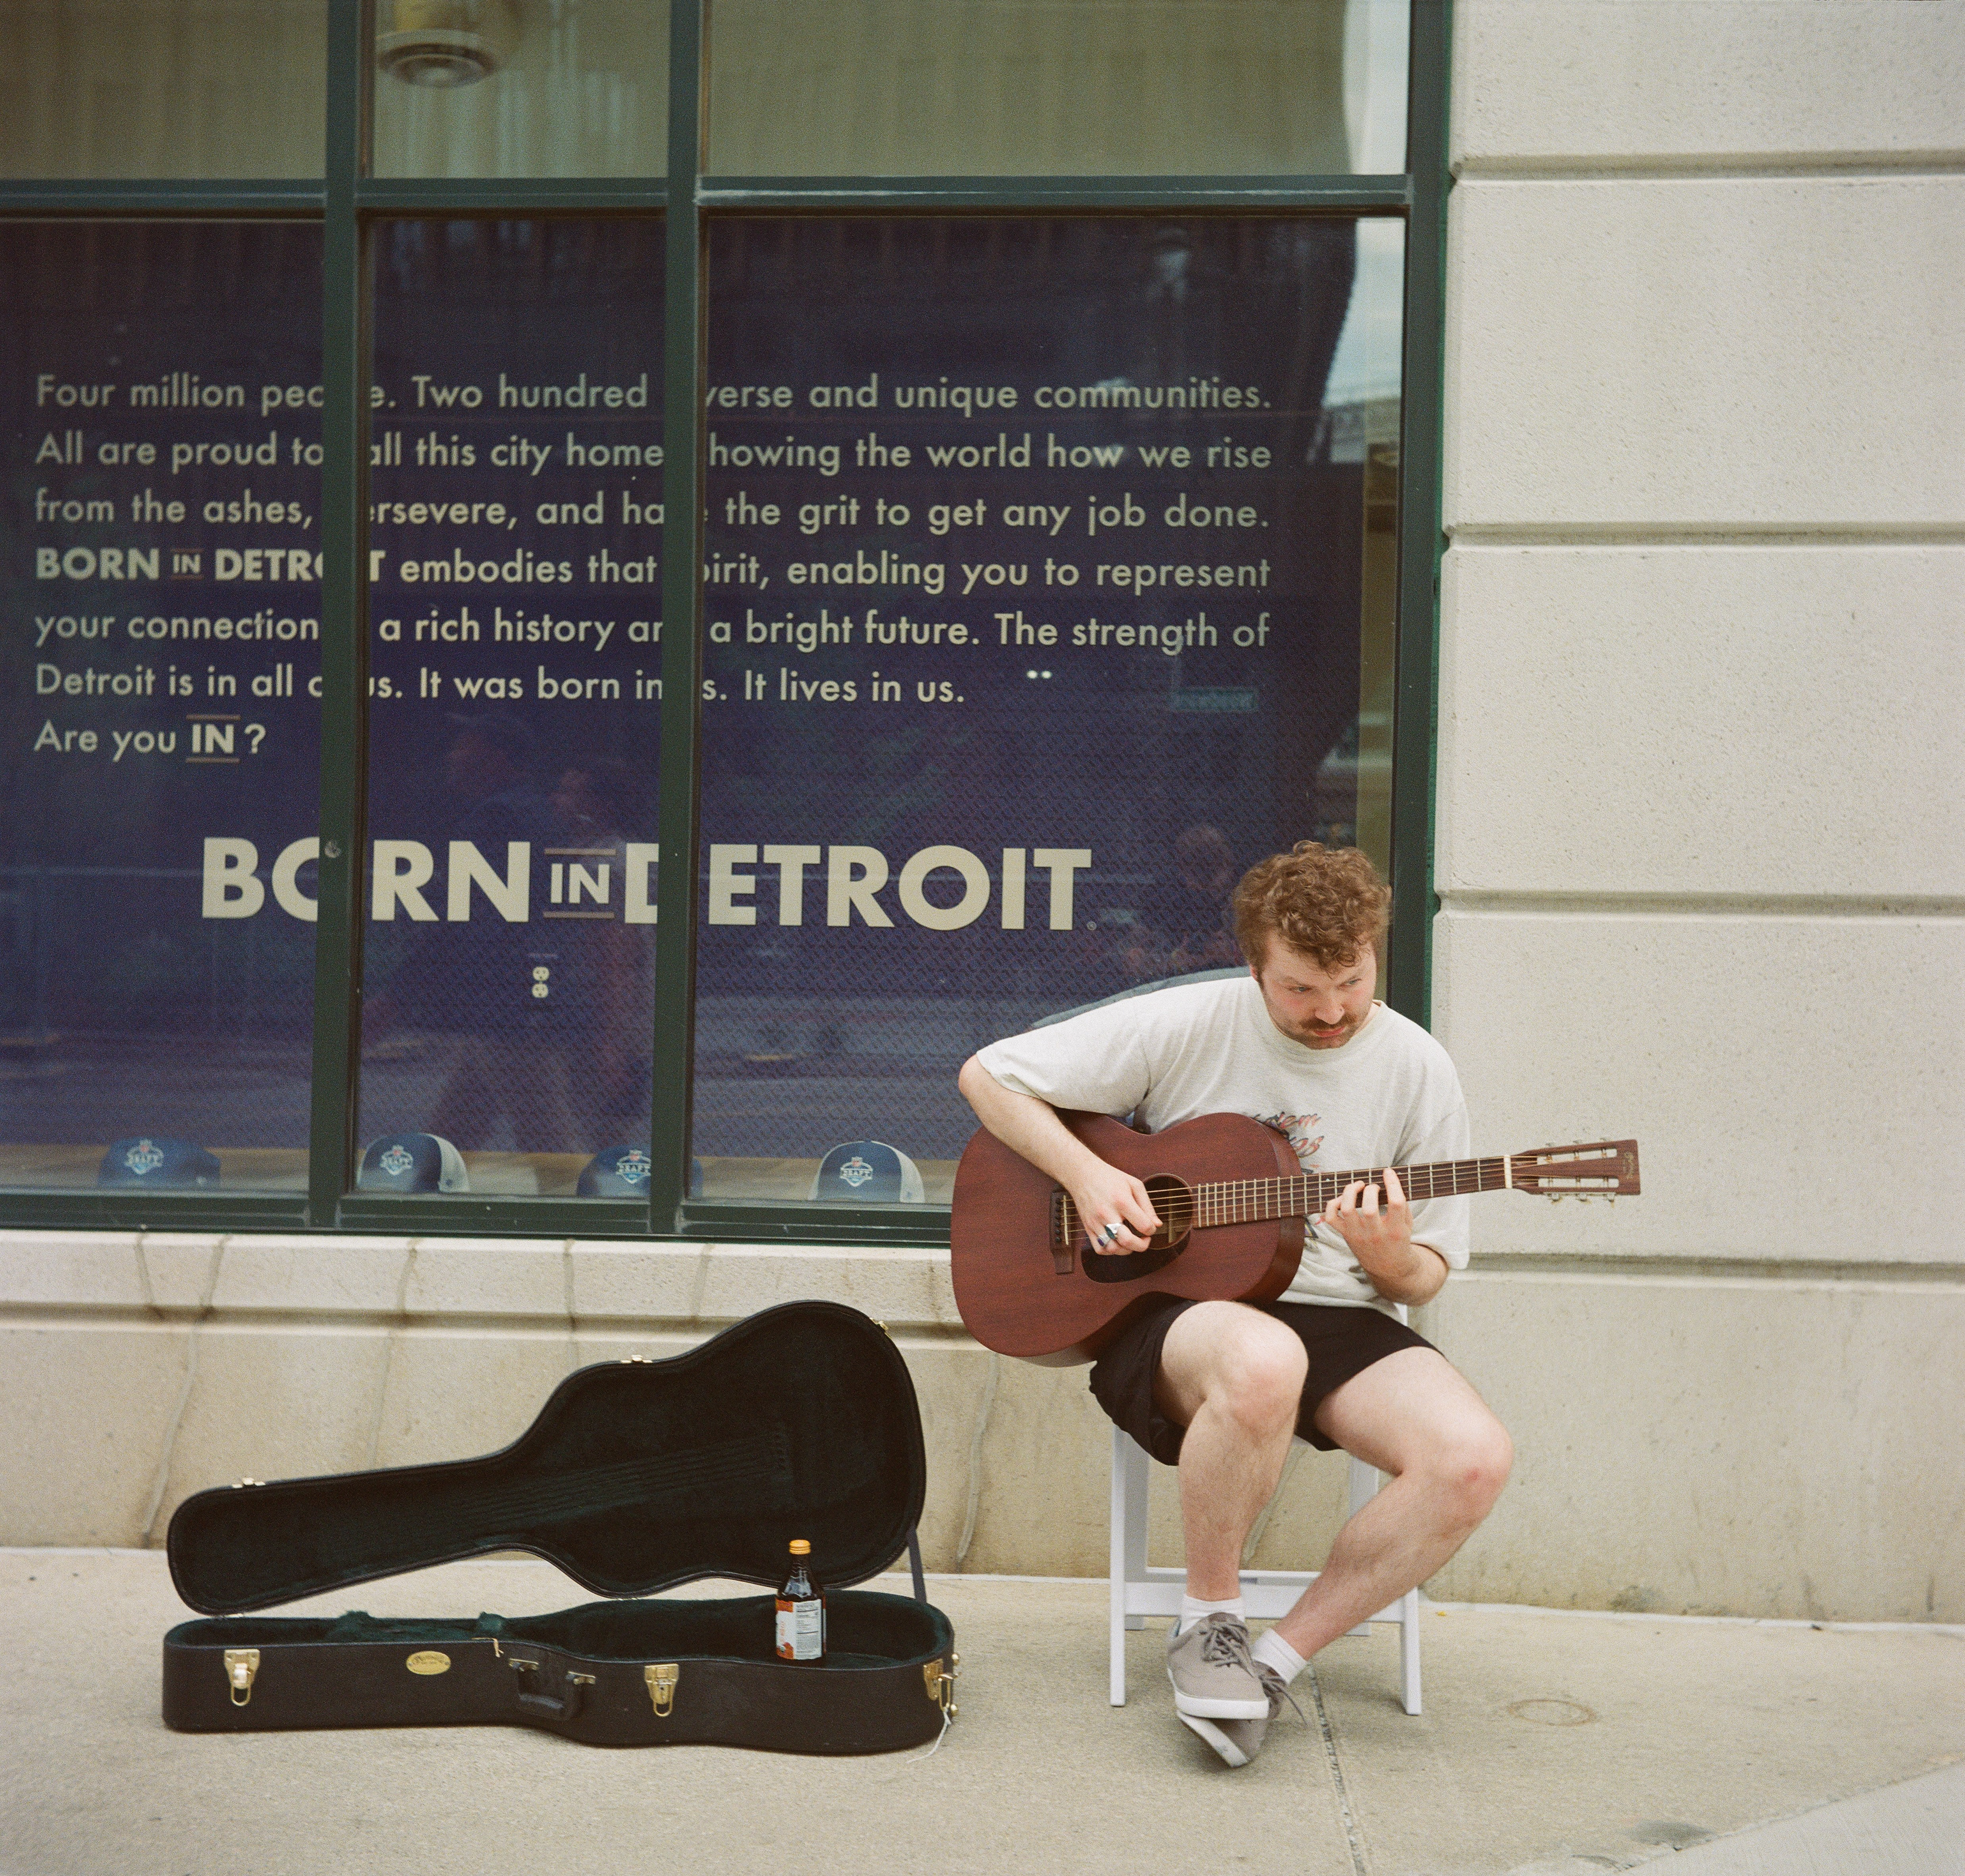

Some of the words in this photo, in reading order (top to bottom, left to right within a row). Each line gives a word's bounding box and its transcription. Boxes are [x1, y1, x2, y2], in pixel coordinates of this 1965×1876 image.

[37, 374, 116, 407] Four
[131, 372, 245, 407] million
[261, 386, 396, 417] peoe.
[411, 375, 483, 408] Two
[499, 373, 647, 408] hundred
[707, 386, 793, 408] verse
[809, 373, 878, 408] and
[896, 377, 1018, 418] unique
[1034, 377, 1270, 409] communities.
[36, 430, 83, 464] All
[99, 443, 157, 465] are
[172, 431, 277, 474] proud
[292, 438, 323, 466] to
[371, 432, 401, 466] all
[416, 432, 476, 467] this
[490, 435, 552, 476] city
[566, 432, 664, 467] home
[710, 432, 840, 477] howing
[856, 432, 911, 467] the
[926, 433, 1031, 468] world
[1047, 433, 1124, 468] how
[1138, 446, 1191, 468] we
[1207, 436, 1271, 468] rise
[36, 488, 115, 522] from
[132, 488, 186, 523] the
[203, 489, 312, 529] ashes,
[370, 502, 517, 530] rsevere,
[536, 491, 603, 524] and
[726, 491, 780, 525] the
[799, 495, 860, 535] grit
[876, 498, 910, 526] to
[928, 499, 987, 535] get
[1003, 505, 1071, 536] any
[1088, 492, 1146, 536] job
[1164, 493, 1268, 527] done.
[37, 547, 159, 580] BORN
[173, 554, 201, 573] IN
[215, 549, 386, 582] DETRT
[400, 548, 573, 583] embodies
[587, 548, 657, 583] that
[703, 553, 769, 590] irit,
[788, 550, 945, 595] enabling
[962, 564, 1028, 595] you
[1044, 558, 1079, 586] to
[1097, 560, 1270, 596] represent
[35, 616, 116, 647] your
[128, 608, 319, 640] connection
[379, 620, 401, 641] a
[416, 607, 479, 642] rich
[494, 607, 615, 651] history
[710, 622, 731, 643] a
[747, 609, 854, 653] bright
[865, 609, 979, 645] future.
[994, 610, 1058, 645] The
[1072, 612, 1217, 656] strength
[1233, 612, 1270, 647] of
[37, 664, 156, 695] Detroit
[169, 665, 193, 696] is
[208, 666, 236, 696] in
[251, 663, 293, 697] all
[420, 667, 442, 698] It
[453, 677, 523, 699] was
[538, 665, 620, 699] born
[636, 669, 662, 699] in
[745, 670, 767, 700] It
[780, 667, 857, 701] lives
[872, 671, 901, 701] in
[918, 681, 964, 702] us.
[34, 720, 98, 752] Are
[113, 731, 176, 762] you
[551, 863, 610, 904] IN
